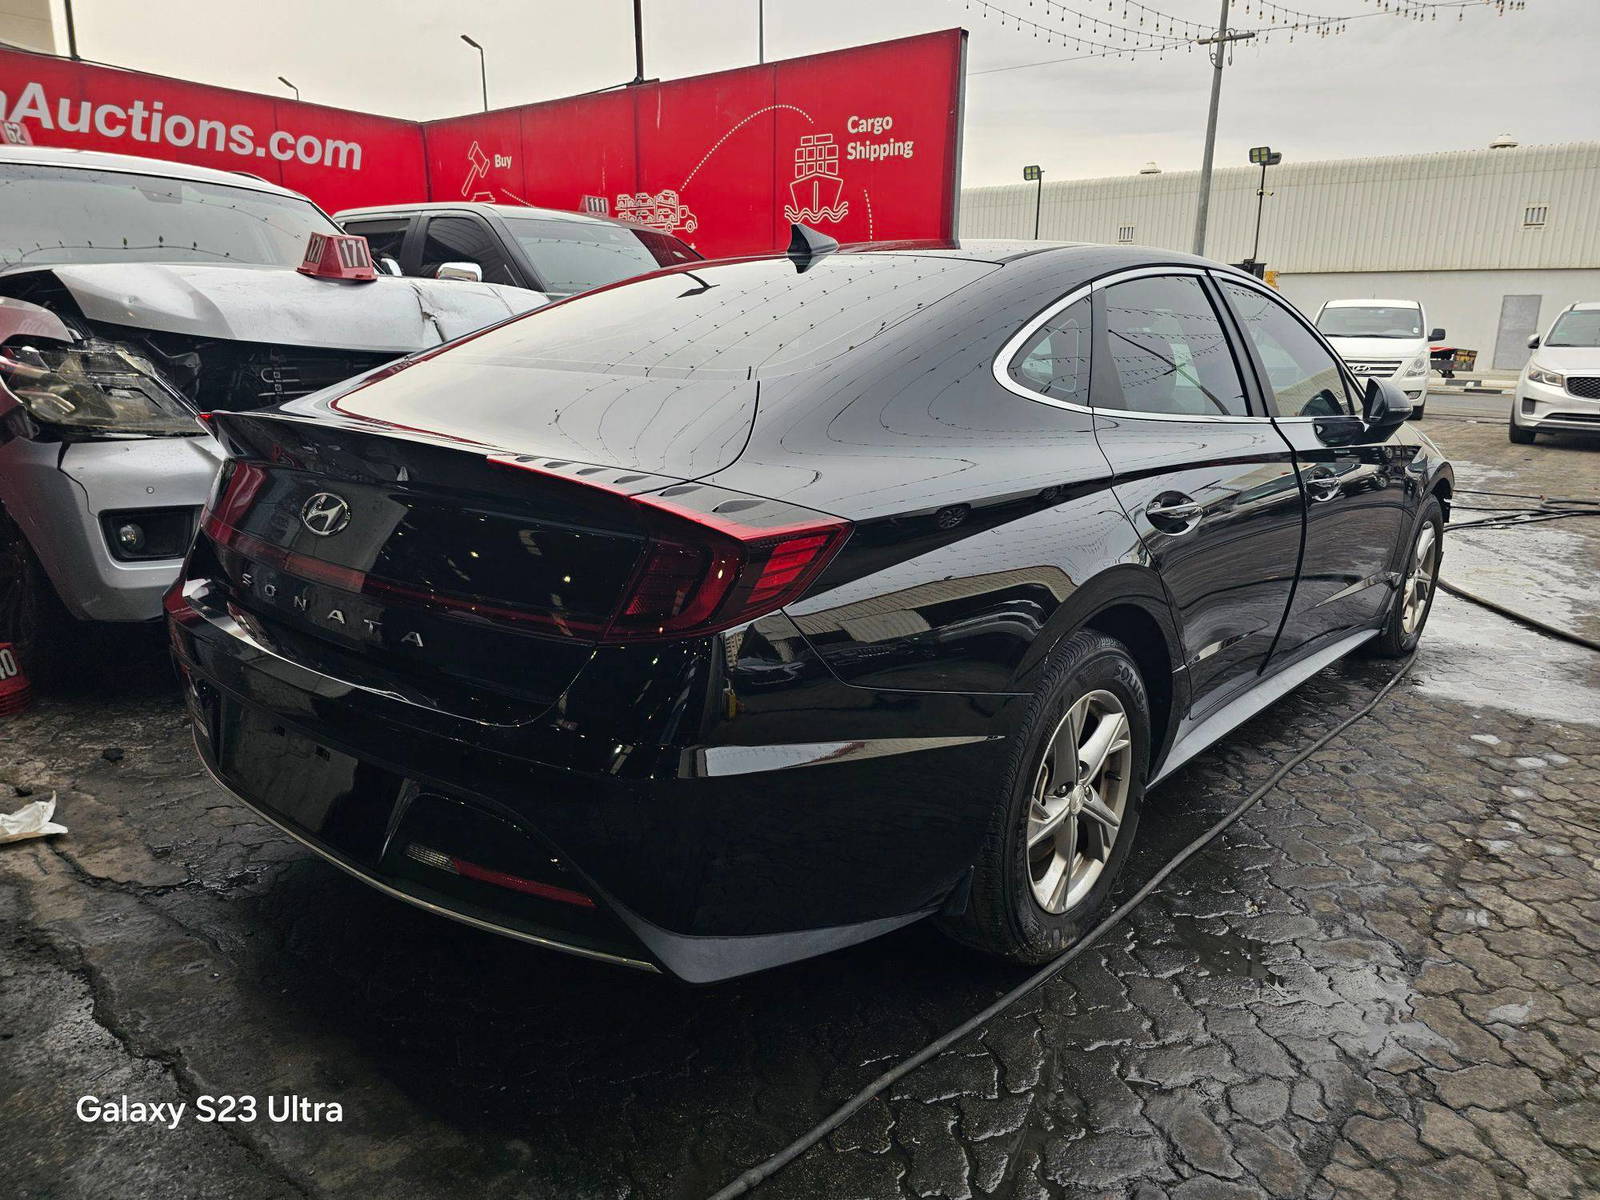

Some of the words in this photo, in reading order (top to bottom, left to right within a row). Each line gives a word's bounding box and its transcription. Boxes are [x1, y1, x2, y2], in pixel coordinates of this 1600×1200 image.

[0, 81, 362, 170] Auctions.com
[847, 115, 893, 135] Cargo
[494, 153, 512, 169] Buy
[847, 138, 914, 161] Shipping
[341, 239, 369, 268] 171
[241, 572, 424, 648] SONATA
